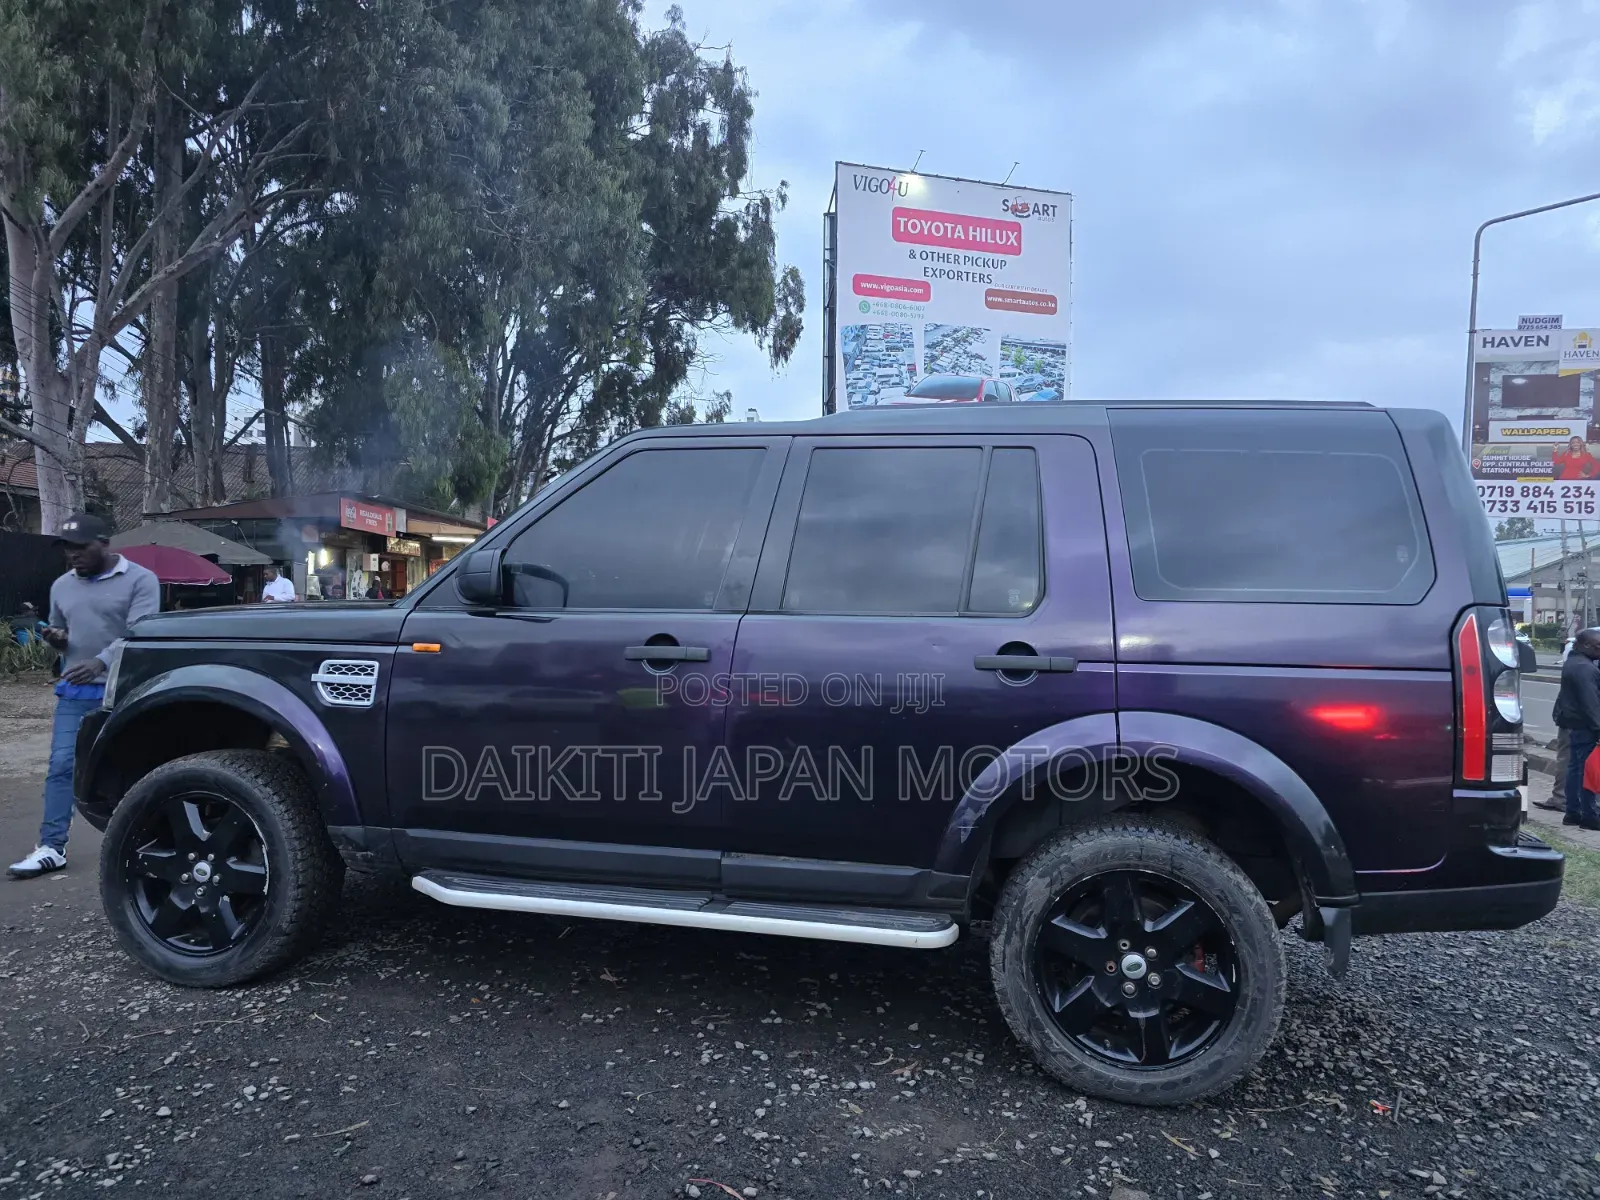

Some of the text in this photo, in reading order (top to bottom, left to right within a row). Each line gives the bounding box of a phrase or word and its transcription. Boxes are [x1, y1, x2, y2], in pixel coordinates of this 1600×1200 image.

[853, 174, 909, 201] VIGO4U
[897, 217, 1019, 247] TOYOTA HILUX
[908, 249, 1008, 270] & OTHER PICKUP
[923, 267, 993, 285] EXPORTERS
[860, 282, 924, 294] www.vigoasia.com
[1482, 335, 1550, 348] HAVEN
[1563, 350, 1600, 358] HAVEN
[1501, 427, 1570, 436] WALLPAPERS
[1477, 485, 1596, 499] 0719 884 234
[1526, 500, 1557, 514] 415
[1563, 500, 1595, 514] 515
